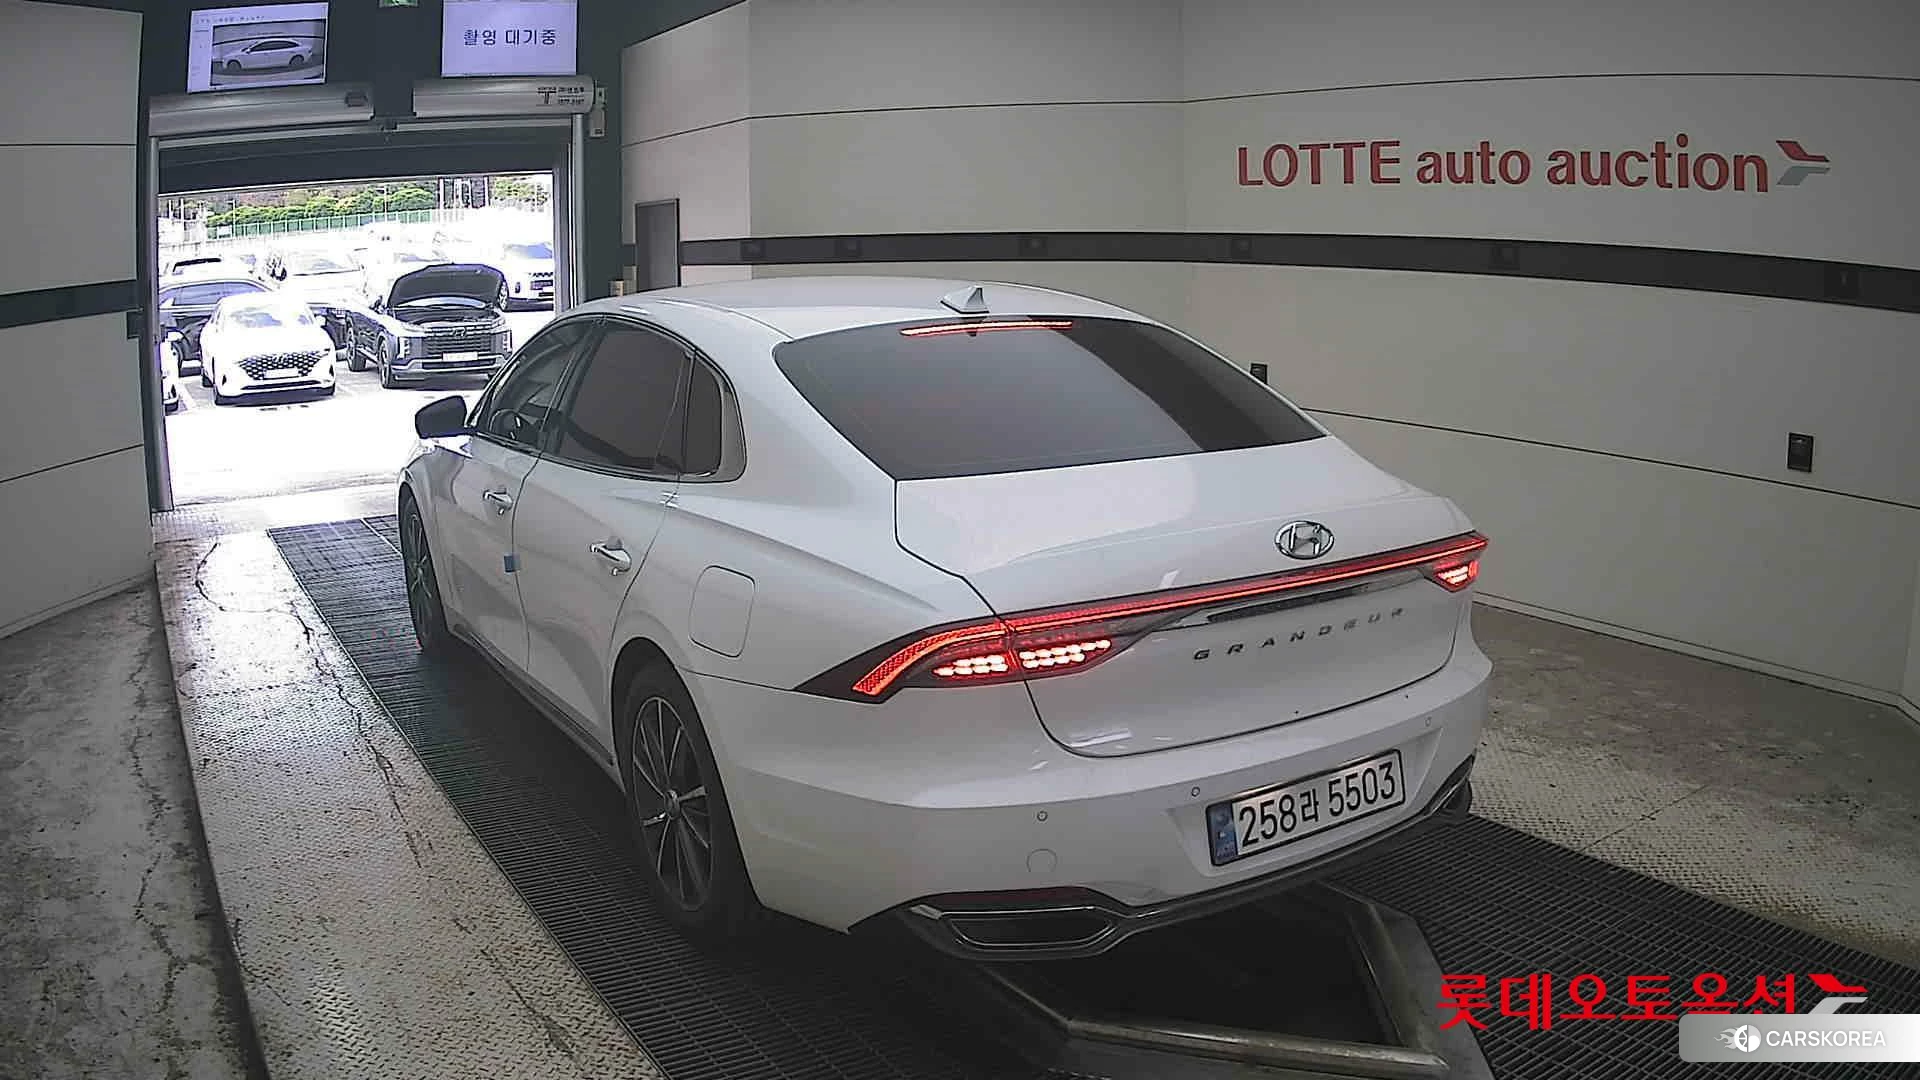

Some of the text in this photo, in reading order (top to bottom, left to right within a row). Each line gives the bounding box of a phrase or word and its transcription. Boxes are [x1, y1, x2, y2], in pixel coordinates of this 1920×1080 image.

[504, 29, 557, 46] 대기중
[1237, 133, 1769, 192] LOTTE auto auction
[1193, 607, 1404, 661] GRANDEUR
[1238, 760, 1397, 848] 258라 5503
